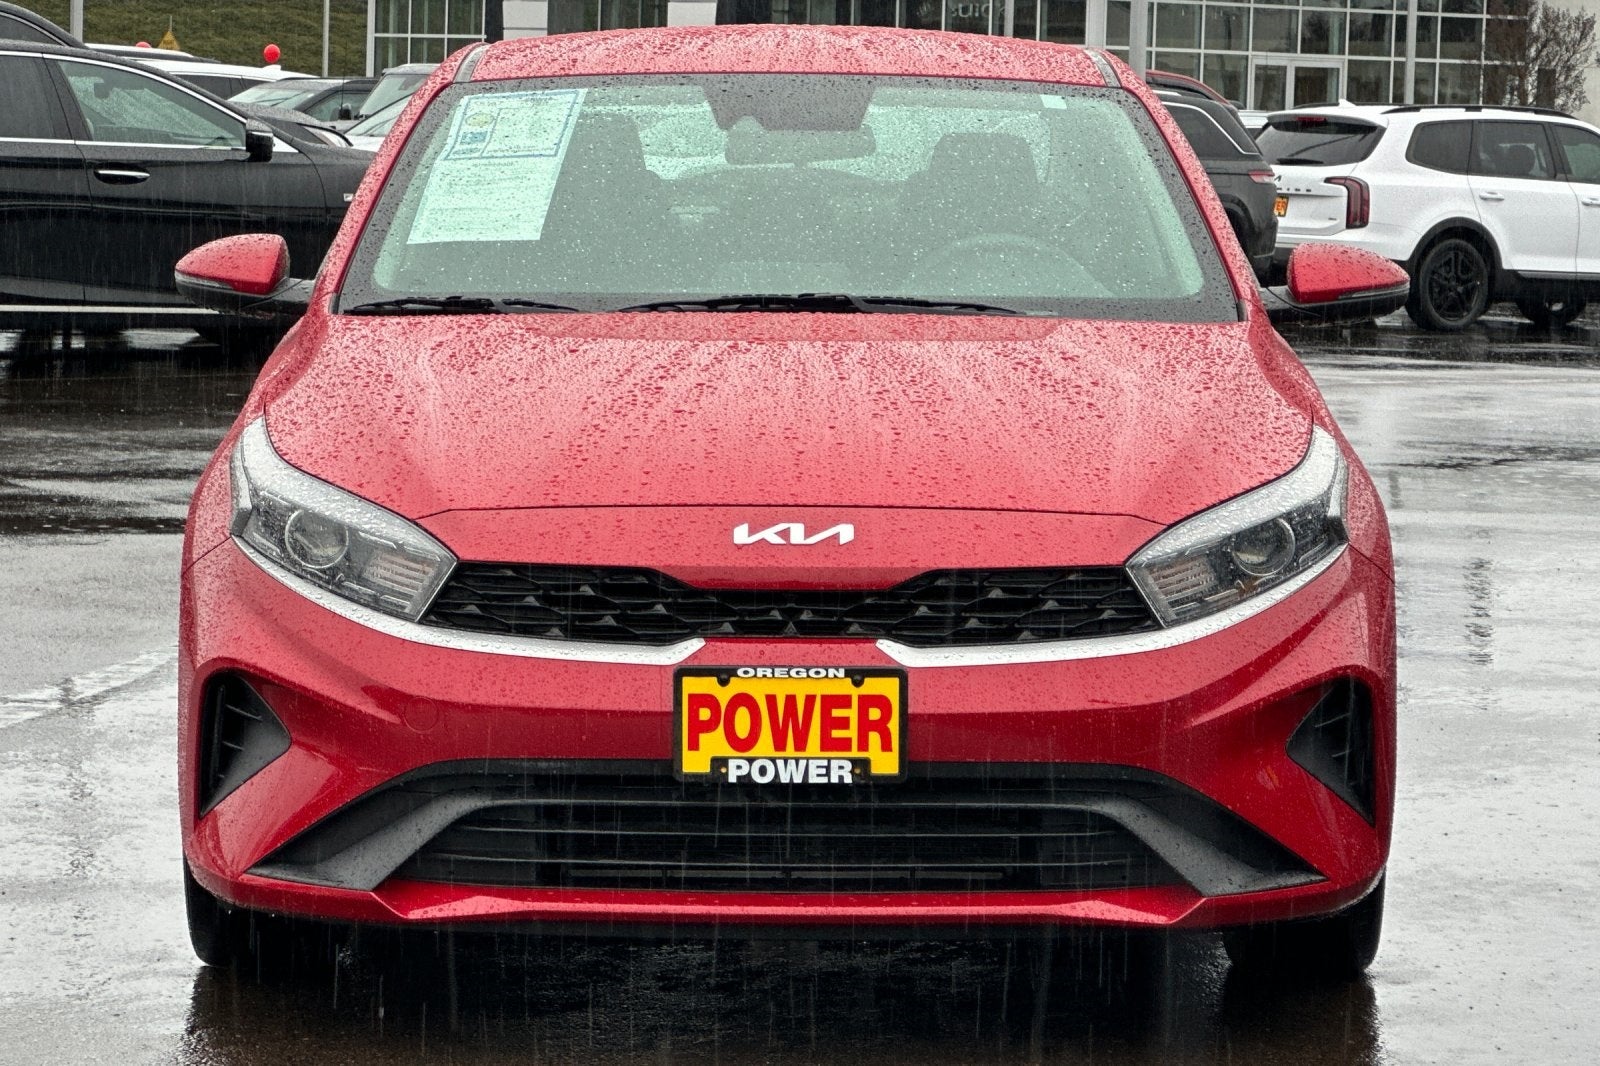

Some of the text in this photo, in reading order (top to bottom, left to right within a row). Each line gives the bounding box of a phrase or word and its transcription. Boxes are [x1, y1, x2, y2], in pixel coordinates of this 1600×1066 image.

[733, 522, 855, 546] KIA
[736, 667, 846, 679] OREGON
[687, 692, 893, 753] POWER
[727, 758, 853, 784] POWER
